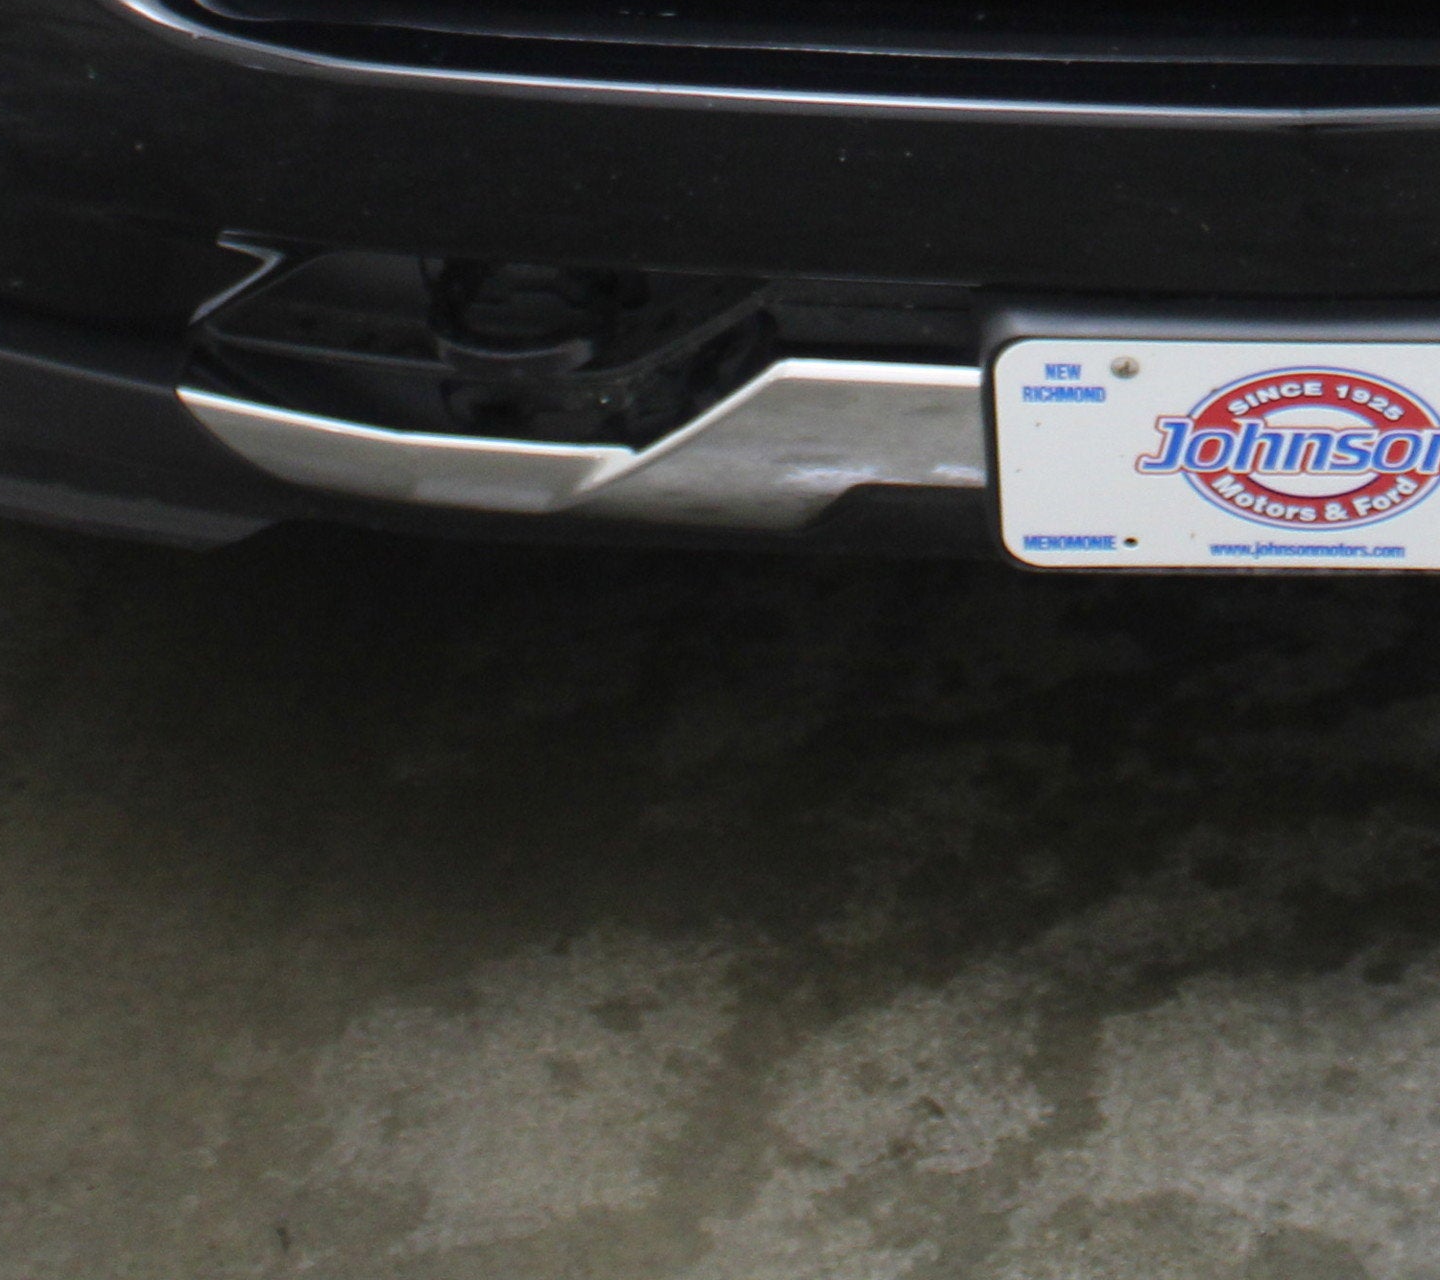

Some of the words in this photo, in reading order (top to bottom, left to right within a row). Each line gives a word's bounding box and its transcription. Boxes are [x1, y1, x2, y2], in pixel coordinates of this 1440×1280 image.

[1045, 363, 1081, 380] NEW
[1023, 386, 1106, 402] RICHMOND
[1227, 381, 1323, 416] SINCE
[1336, 384, 1405, 422] 1925
[1211, 474, 1317, 522] Motors
[1323, 502, 1350, 522] &
[1354, 476, 1420, 517] Ford
